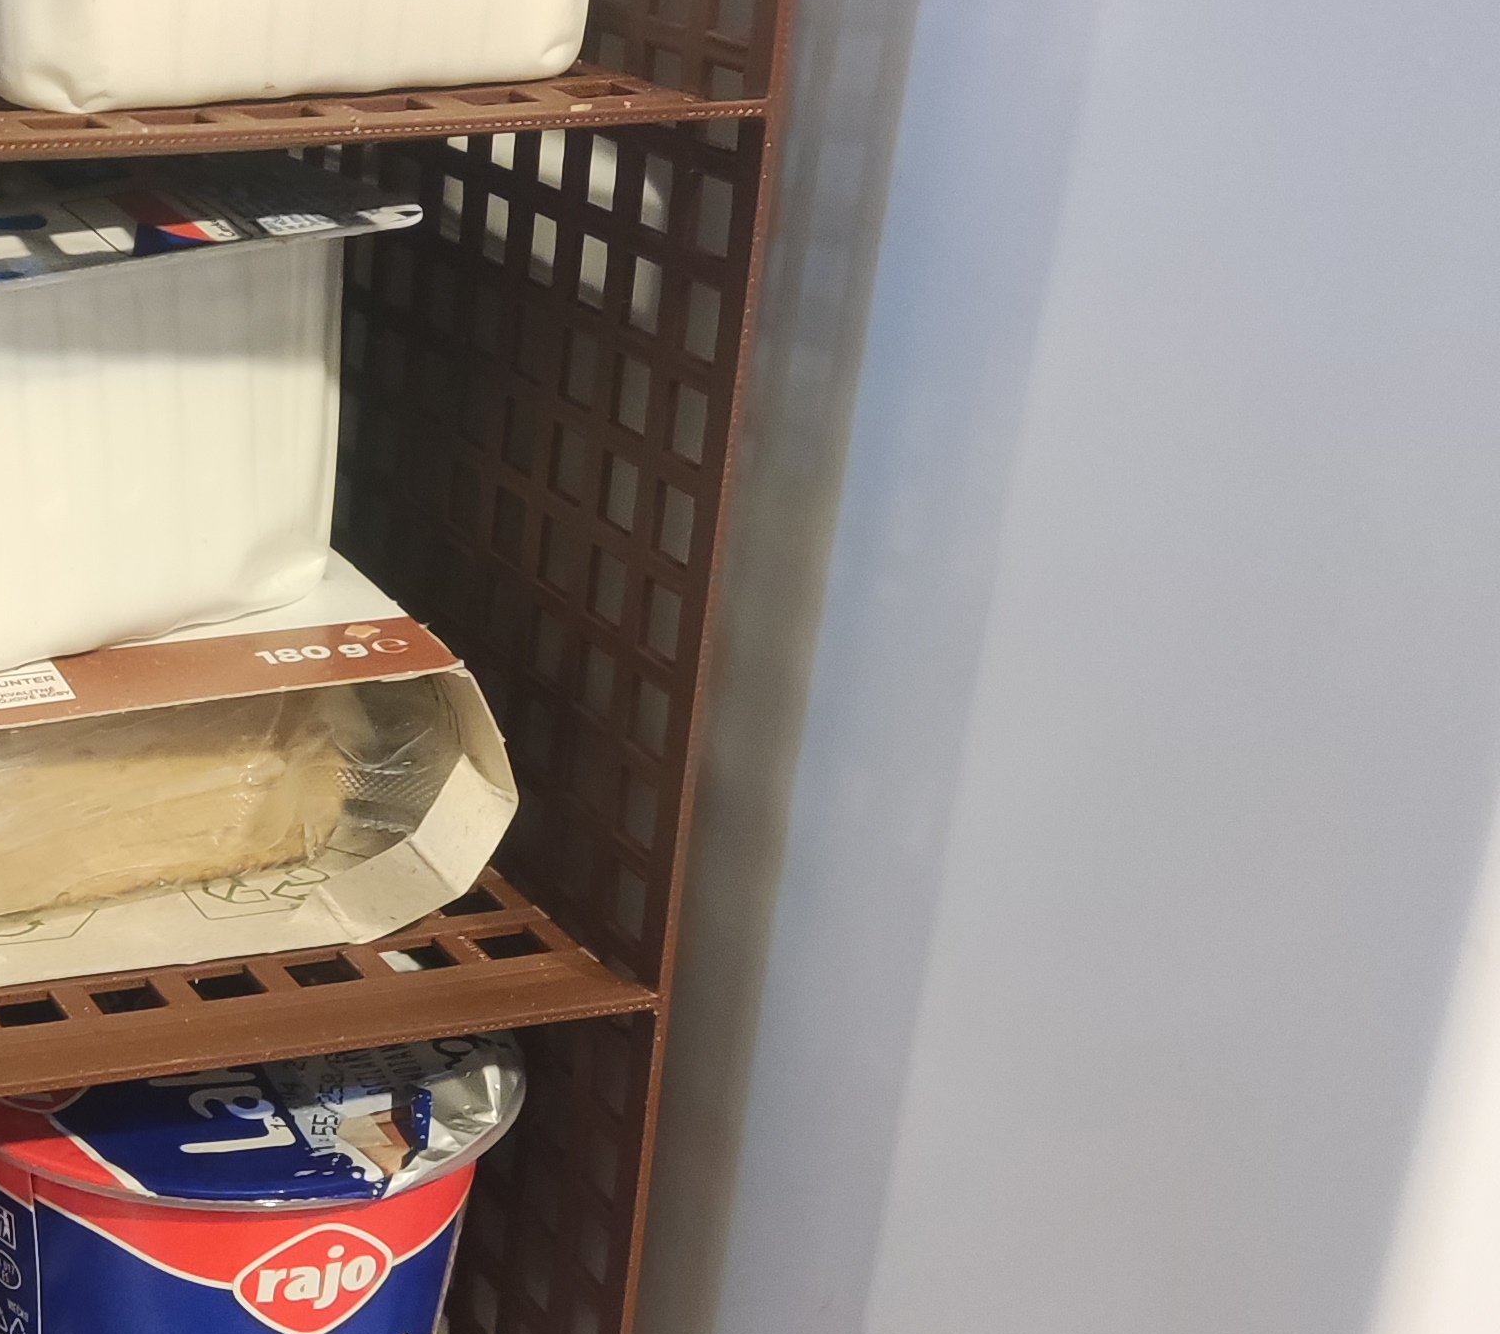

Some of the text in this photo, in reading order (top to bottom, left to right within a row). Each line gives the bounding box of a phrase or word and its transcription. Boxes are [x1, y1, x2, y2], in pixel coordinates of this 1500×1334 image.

[253, 644, 332, 666] 180
[337, 642, 370, 659] g
[255, 1244, 377, 1311] rajo
